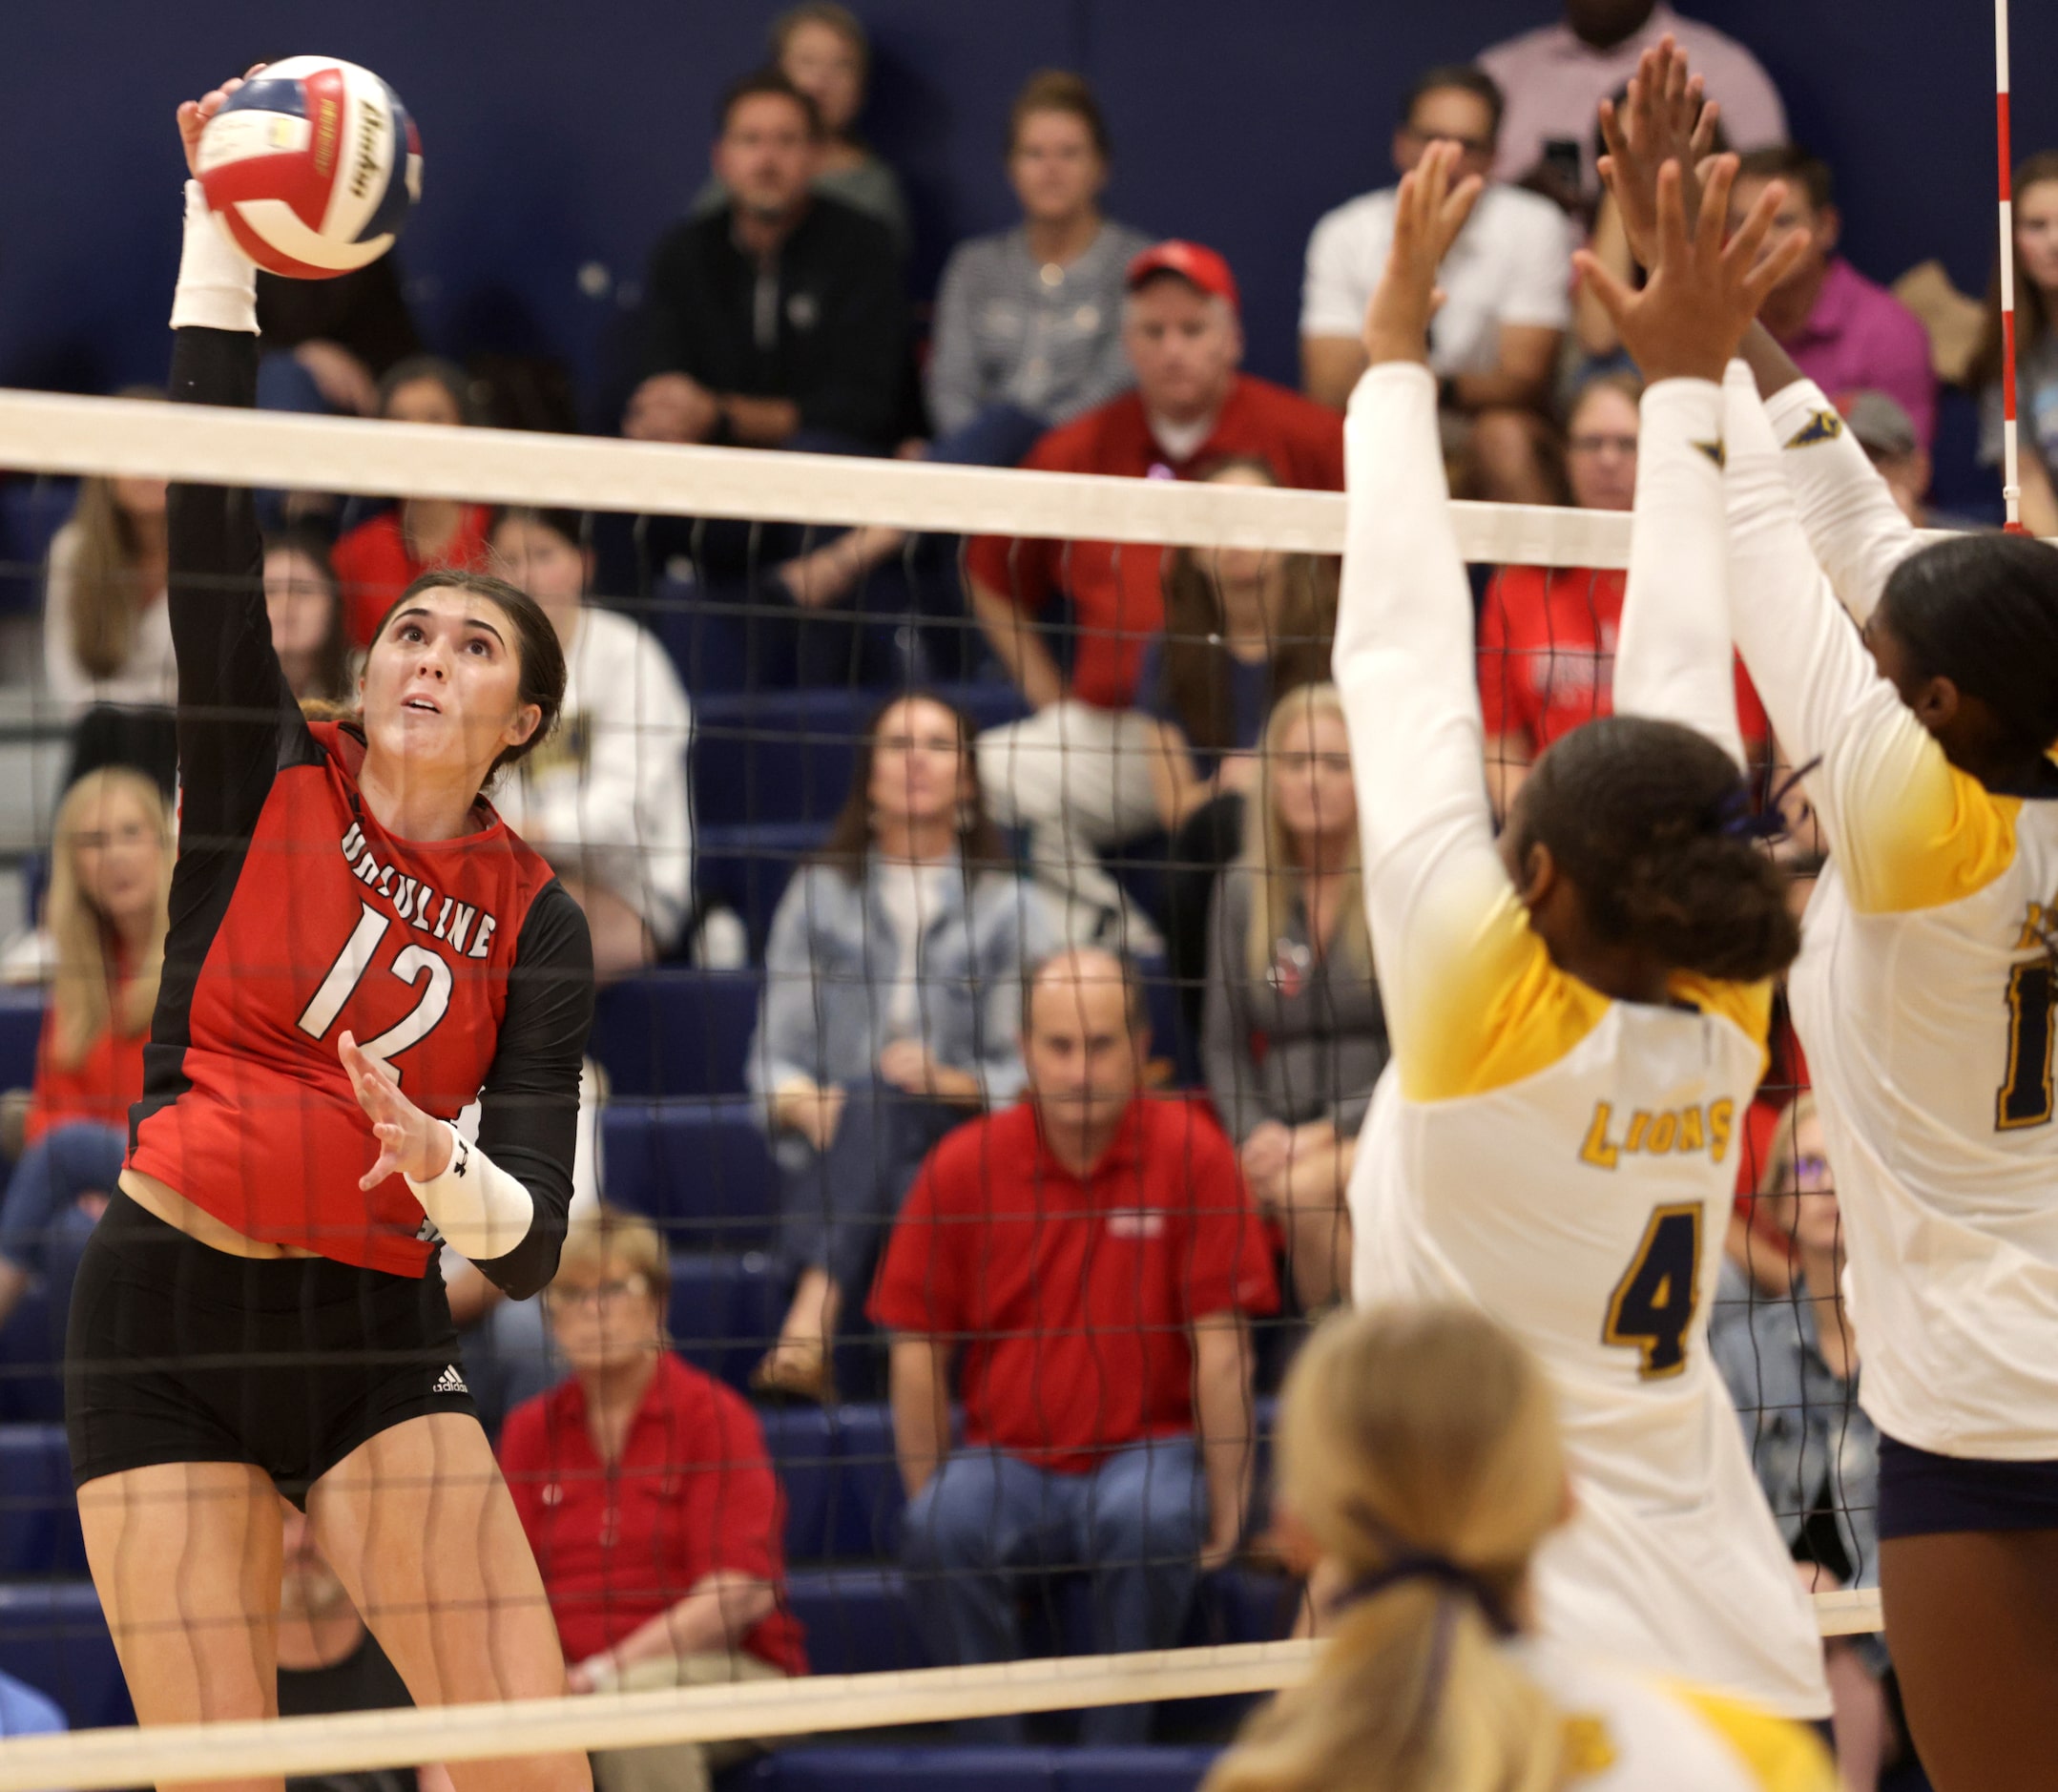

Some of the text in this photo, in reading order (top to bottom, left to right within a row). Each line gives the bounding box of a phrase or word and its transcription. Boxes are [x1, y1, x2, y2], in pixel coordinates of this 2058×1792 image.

[341, 822, 496, 958] URSULINE
[295, 898, 453, 1090] 12
[1995, 958, 2058, 1133] 1
[1578, 1097, 1734, 1171] LIONS
[1601, 1200, 1704, 1382] 4
[432, 1381, 468, 1393] adida
